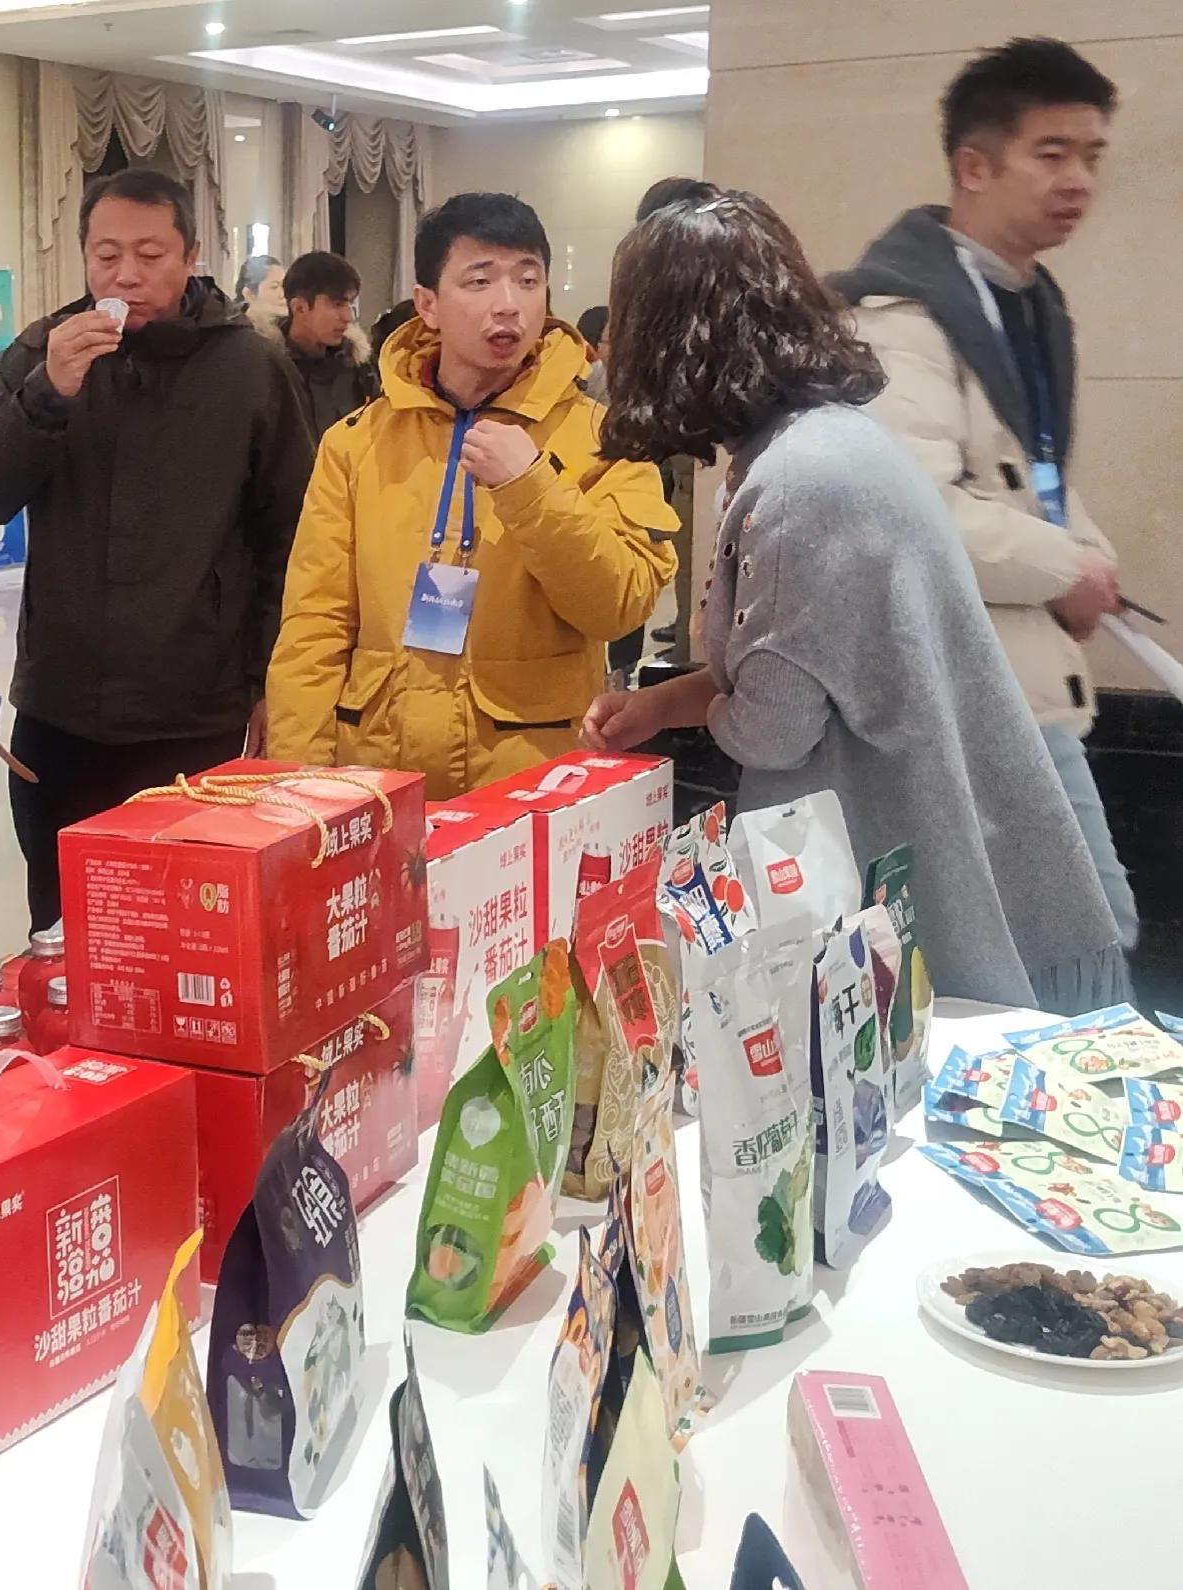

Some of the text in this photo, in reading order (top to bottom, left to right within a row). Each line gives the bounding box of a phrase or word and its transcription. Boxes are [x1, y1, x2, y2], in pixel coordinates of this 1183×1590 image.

[326, 872, 368, 924] 大果粒
[469, 882, 528, 947] 沙甜果粒
[326, 909, 368, 962] 番茄汁
[484, 927, 528, 985] 番茄汁
[321, 1079, 361, 1134] 大果粒
[34, 1275, 142, 1362] 沙甜果粒番茄汁
